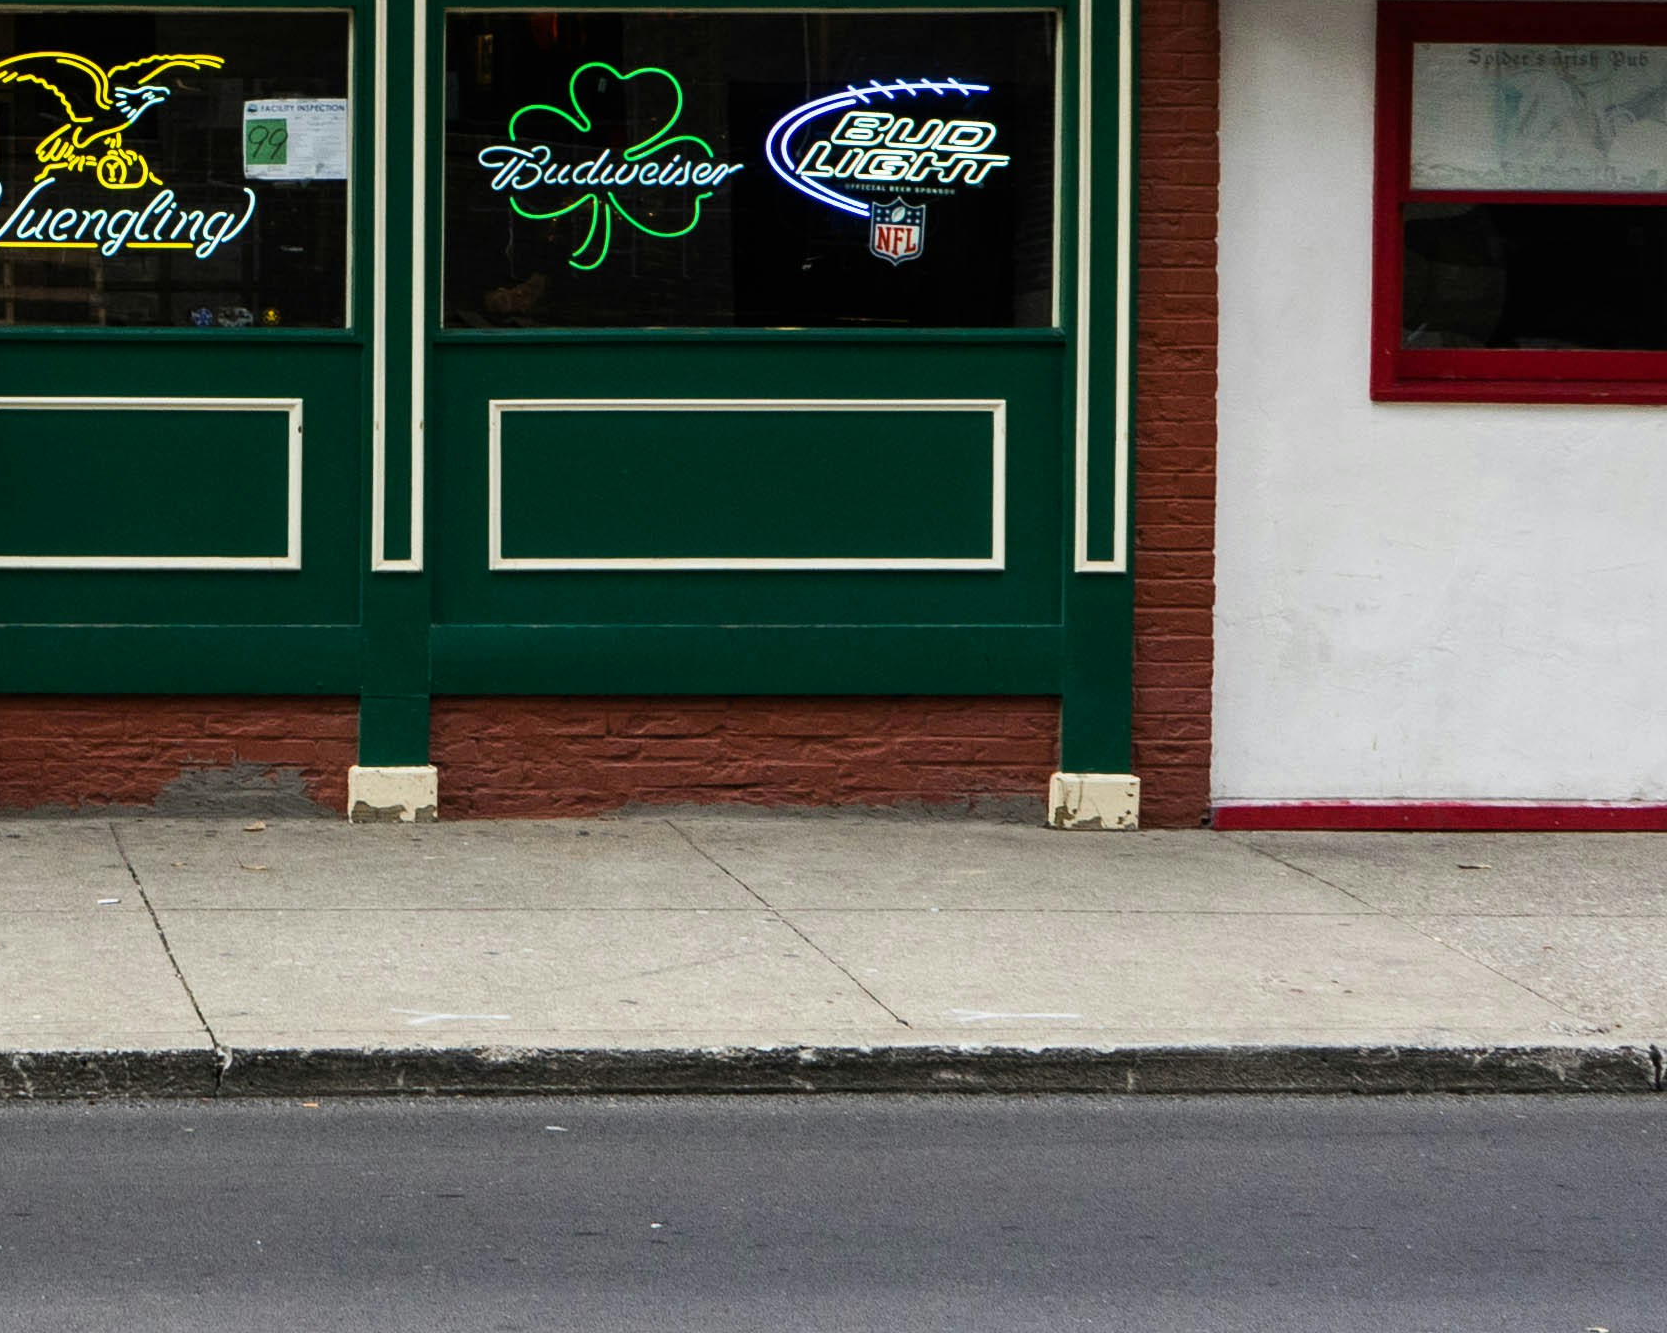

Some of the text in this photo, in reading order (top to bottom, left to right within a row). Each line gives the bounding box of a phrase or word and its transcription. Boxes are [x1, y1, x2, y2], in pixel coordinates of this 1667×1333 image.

[248, 125, 288, 160] 99
[831, 111, 997, 152] BUD
[478, 145, 744, 191] Budweiser
[795, 141, 1011, 184] LIGHT
[876, 226, 916, 256] NFL
